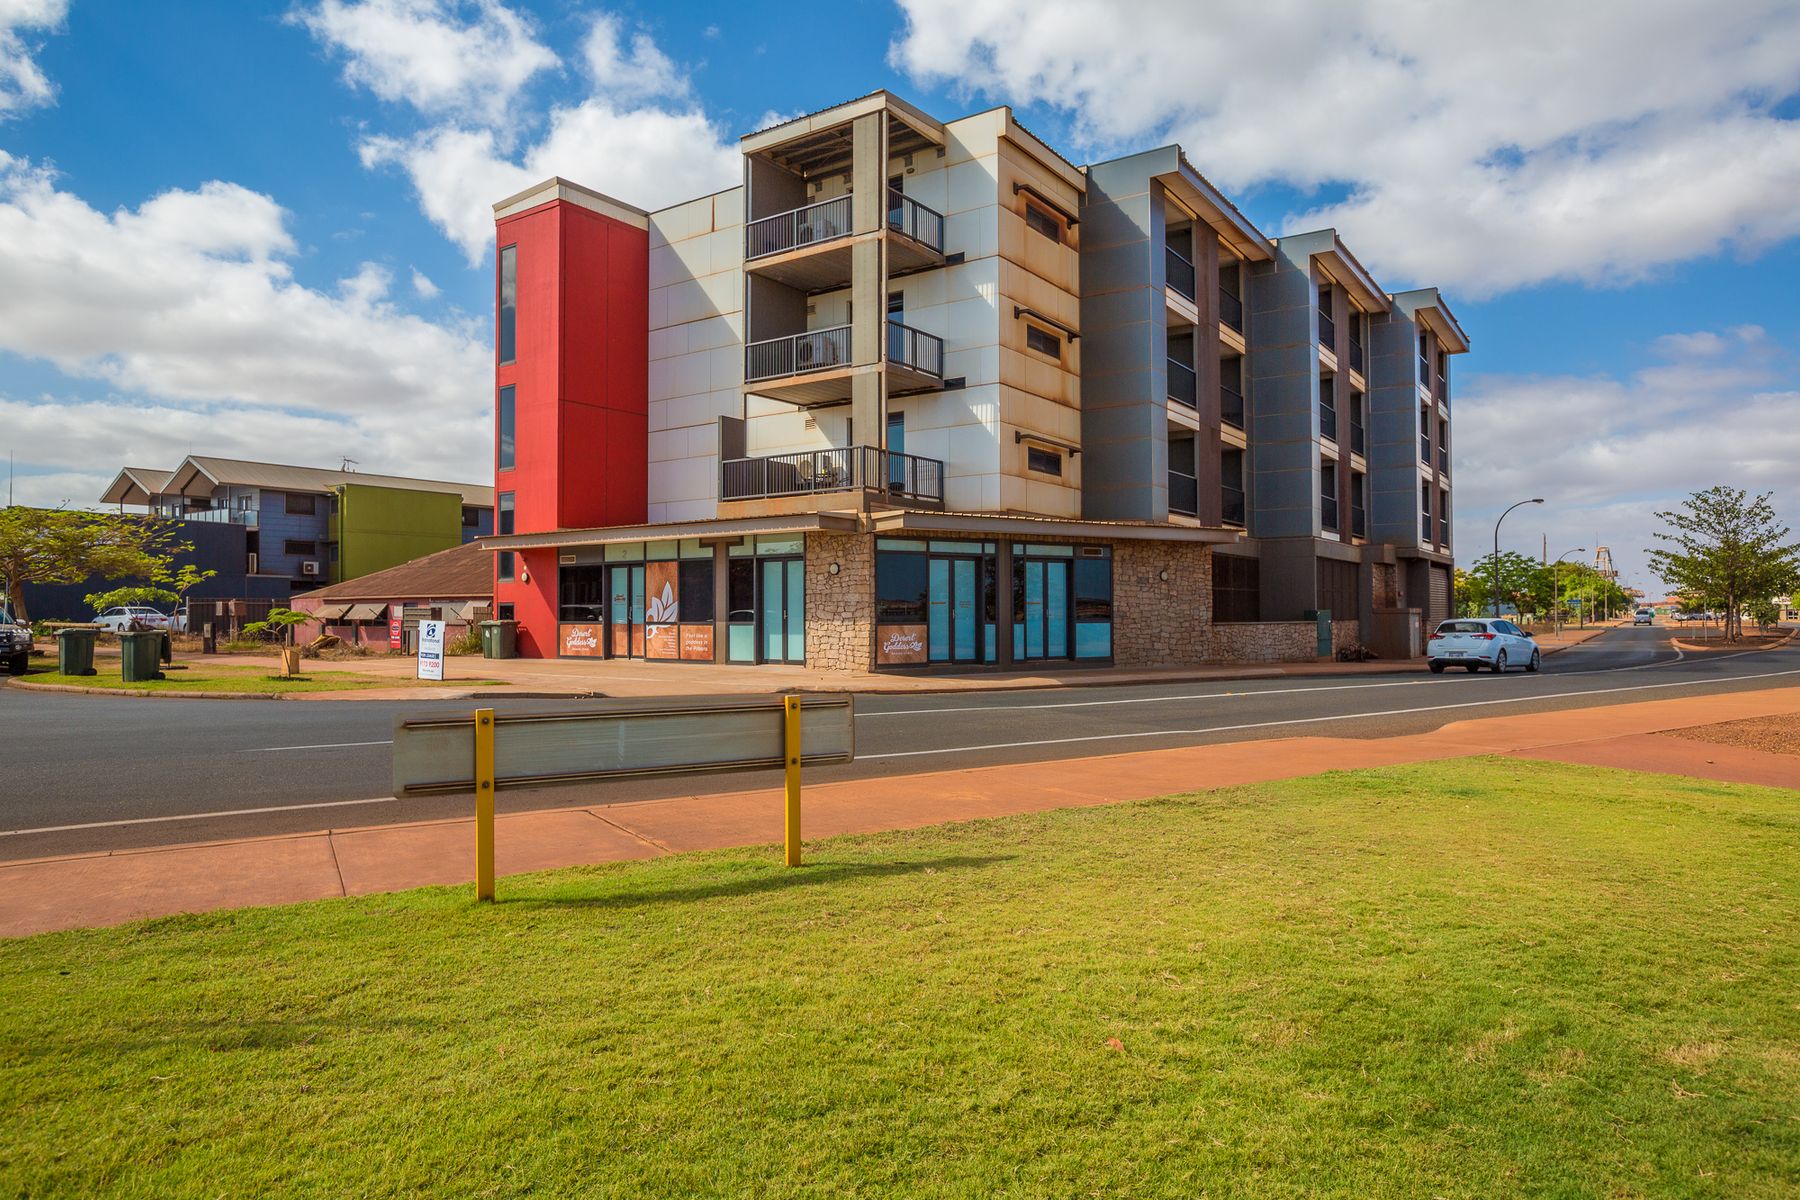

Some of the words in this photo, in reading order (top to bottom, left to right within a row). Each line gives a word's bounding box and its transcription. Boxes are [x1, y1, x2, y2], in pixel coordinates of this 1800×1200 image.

[571, 628, 592, 637] Desert
[890, 632, 916, 642] Desert
[883, 641, 911, 653] Goddess
